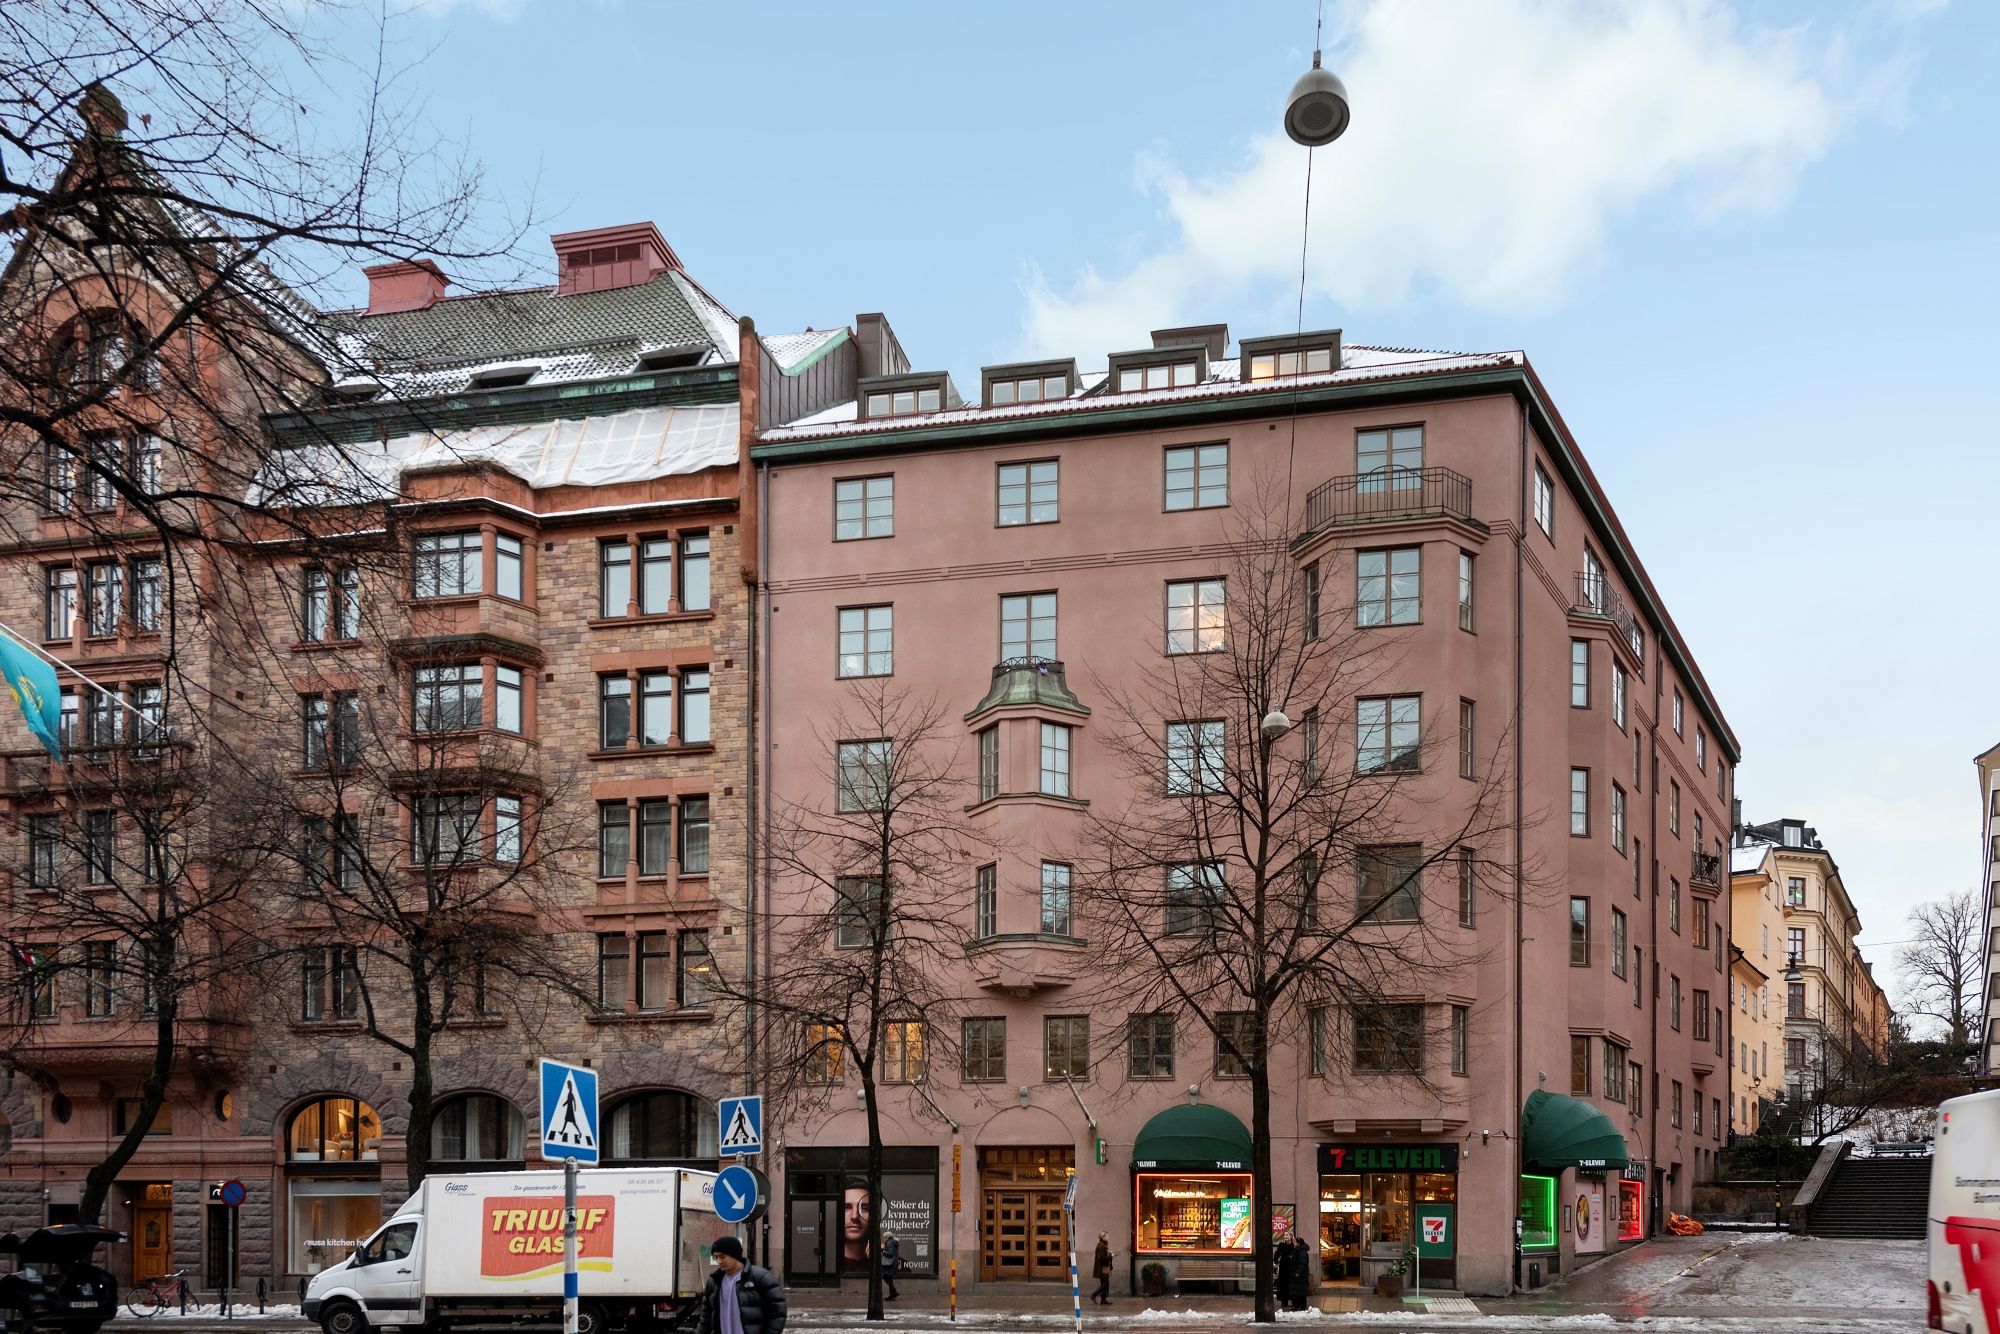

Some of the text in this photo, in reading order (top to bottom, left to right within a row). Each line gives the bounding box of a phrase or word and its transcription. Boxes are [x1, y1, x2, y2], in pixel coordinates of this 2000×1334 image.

[445, 1182, 469, 1192] Glass
[702, 1182, 714, 1194] Gla
[890, 1200, 930, 1209] Söker du
[888, 1210, 930, 1219] kvm med
[491, 1208, 606, 1232] TRIUMF
[326, 1238, 355, 1246] kitchen
[903, 1261, 929, 1269] NOVIER
